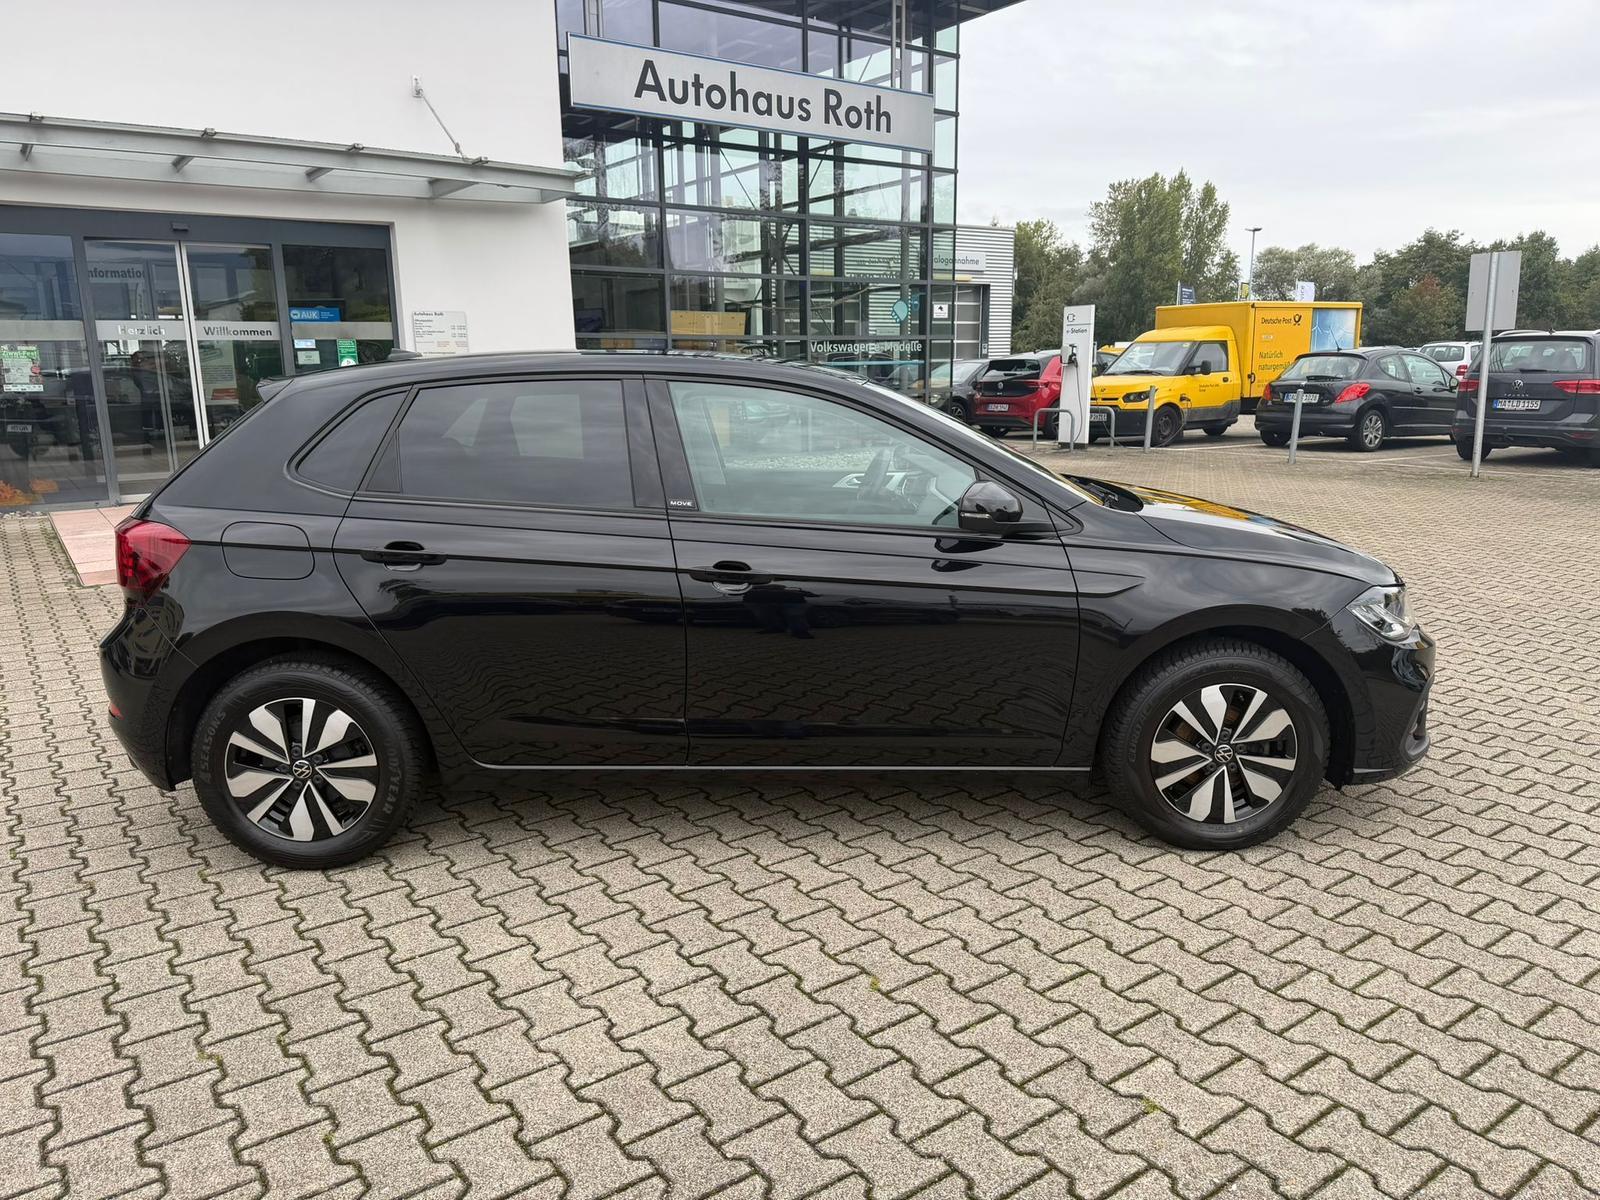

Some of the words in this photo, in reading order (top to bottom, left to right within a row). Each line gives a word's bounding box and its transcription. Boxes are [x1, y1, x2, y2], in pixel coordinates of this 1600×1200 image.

[634, 59, 812, 122] Autohaus
[824, 88, 892, 134] Roth
[88, 267, 145, 278] nformatio
[117, 325, 165, 335] Herzlich
[203, 325, 273, 336] Willkommen
[810, 341, 871, 354] Volkswagen
[1258, 350, 1284, 359] Natürlich
